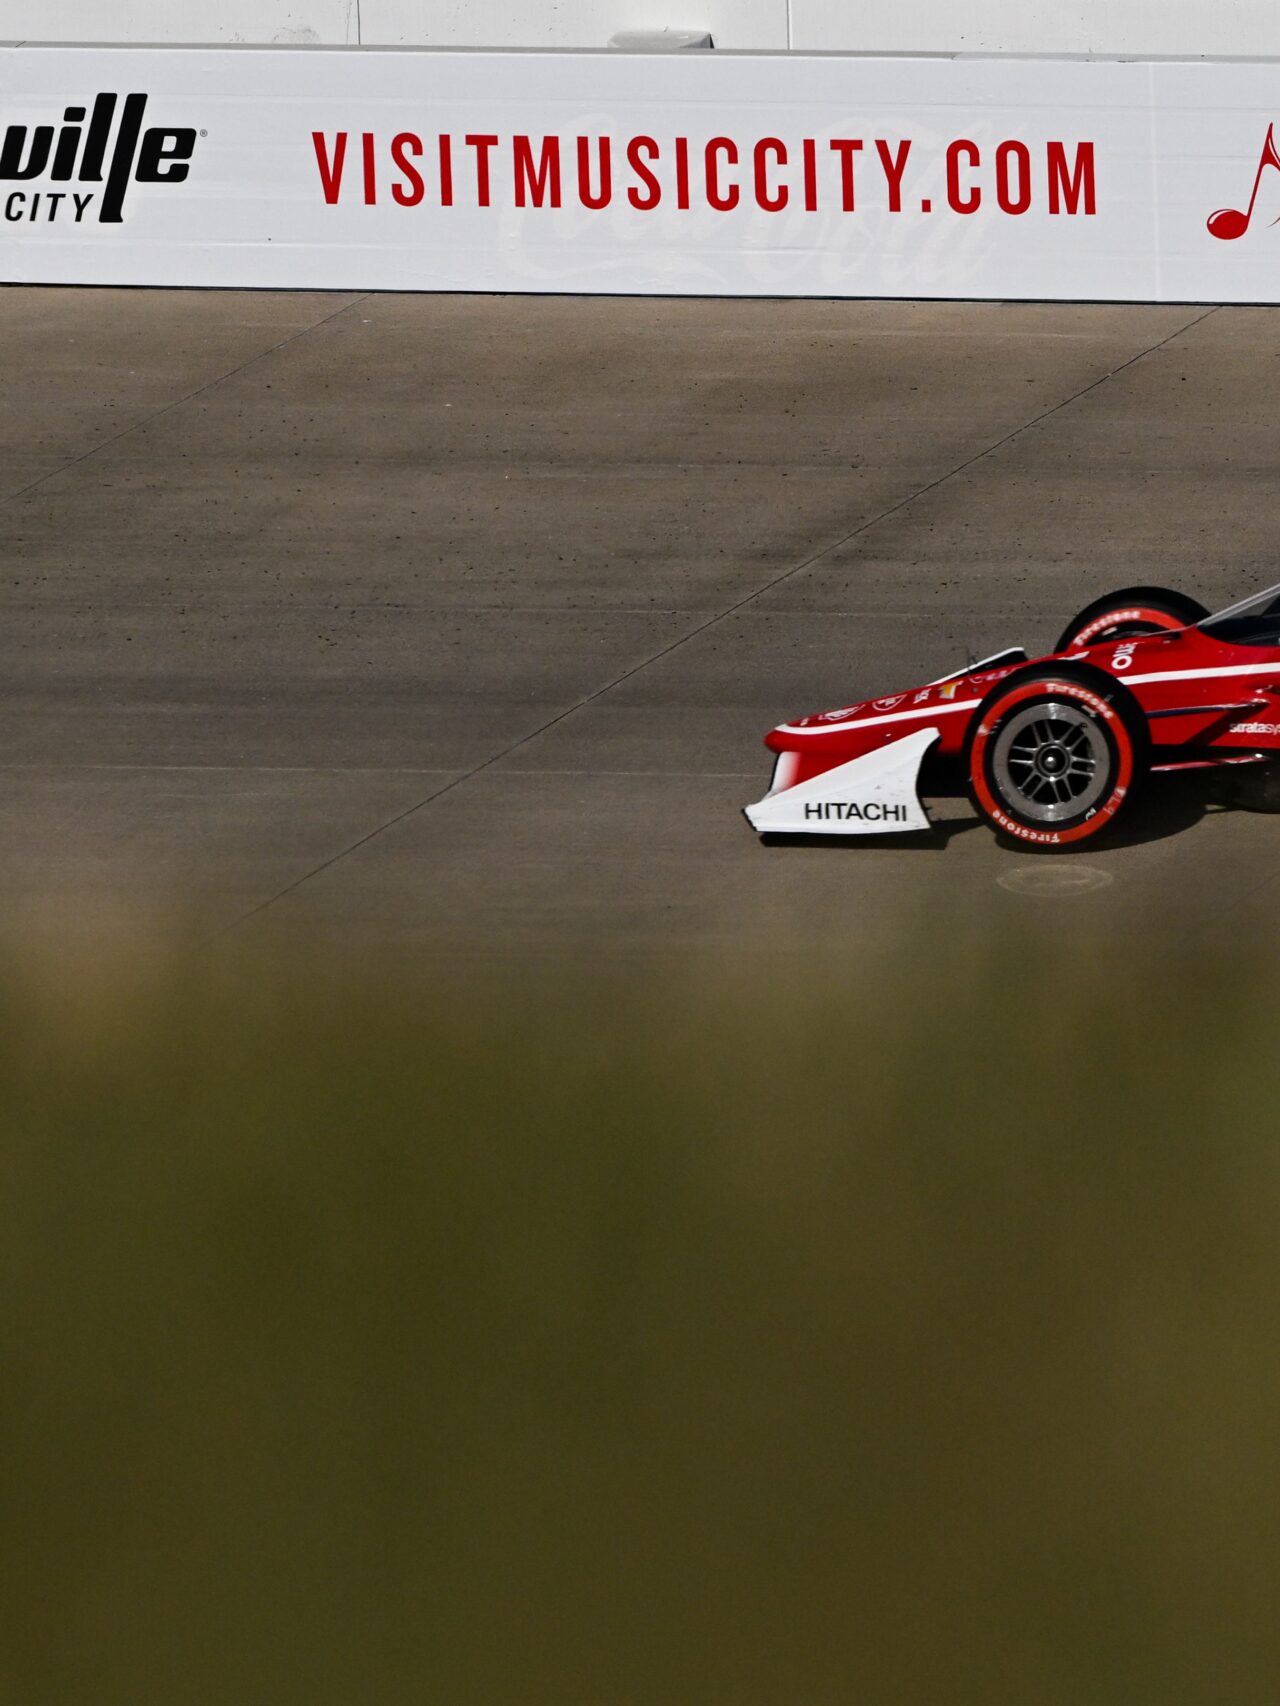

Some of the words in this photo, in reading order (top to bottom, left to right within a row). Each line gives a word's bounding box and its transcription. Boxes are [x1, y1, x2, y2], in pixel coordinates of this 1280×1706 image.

[312, 131, 1096, 216] VISITMUSICCITY.COM
[5, 192, 94, 222] CITY
[1046, 682, 1113, 719] Firestone
[804, 802, 908, 822] HITACHI
[992, 810, 1061, 843] Firestone
